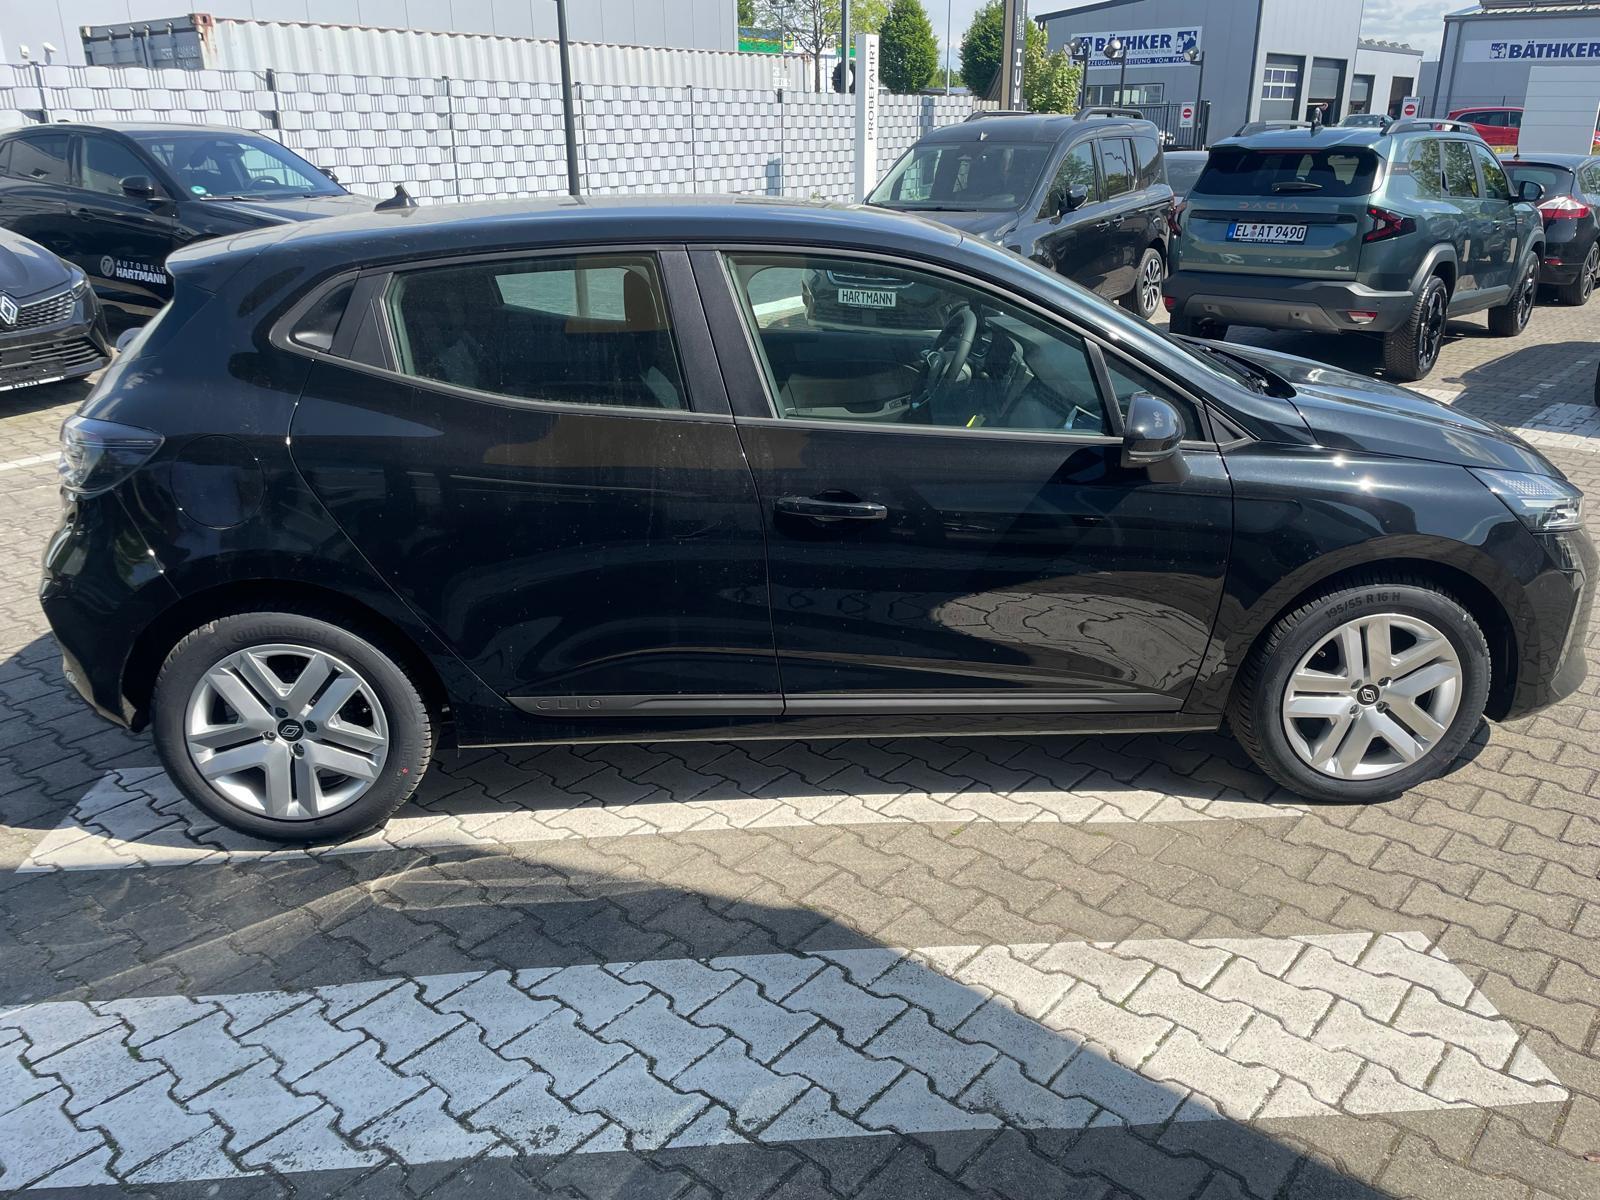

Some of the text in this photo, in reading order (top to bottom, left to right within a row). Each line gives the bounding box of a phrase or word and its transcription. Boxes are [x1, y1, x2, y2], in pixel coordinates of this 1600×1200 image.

[1094, 34, 1172, 52] BÄTHKER
[1508, 41, 1600, 59] BÄTHKER
[867, 43, 876, 141] PROBEFAHRT
[1238, 202, 1299, 210] DACIA
[1235, 224, 1305, 239] EL AT 9490
[116, 260, 165, 273] AUTOWELT
[116, 268, 167, 284] HARTMANN
[842, 290, 892, 305] HARTMANN
[1376, 592, 1388, 602] 16
[536, 700, 602, 710] CLIO
